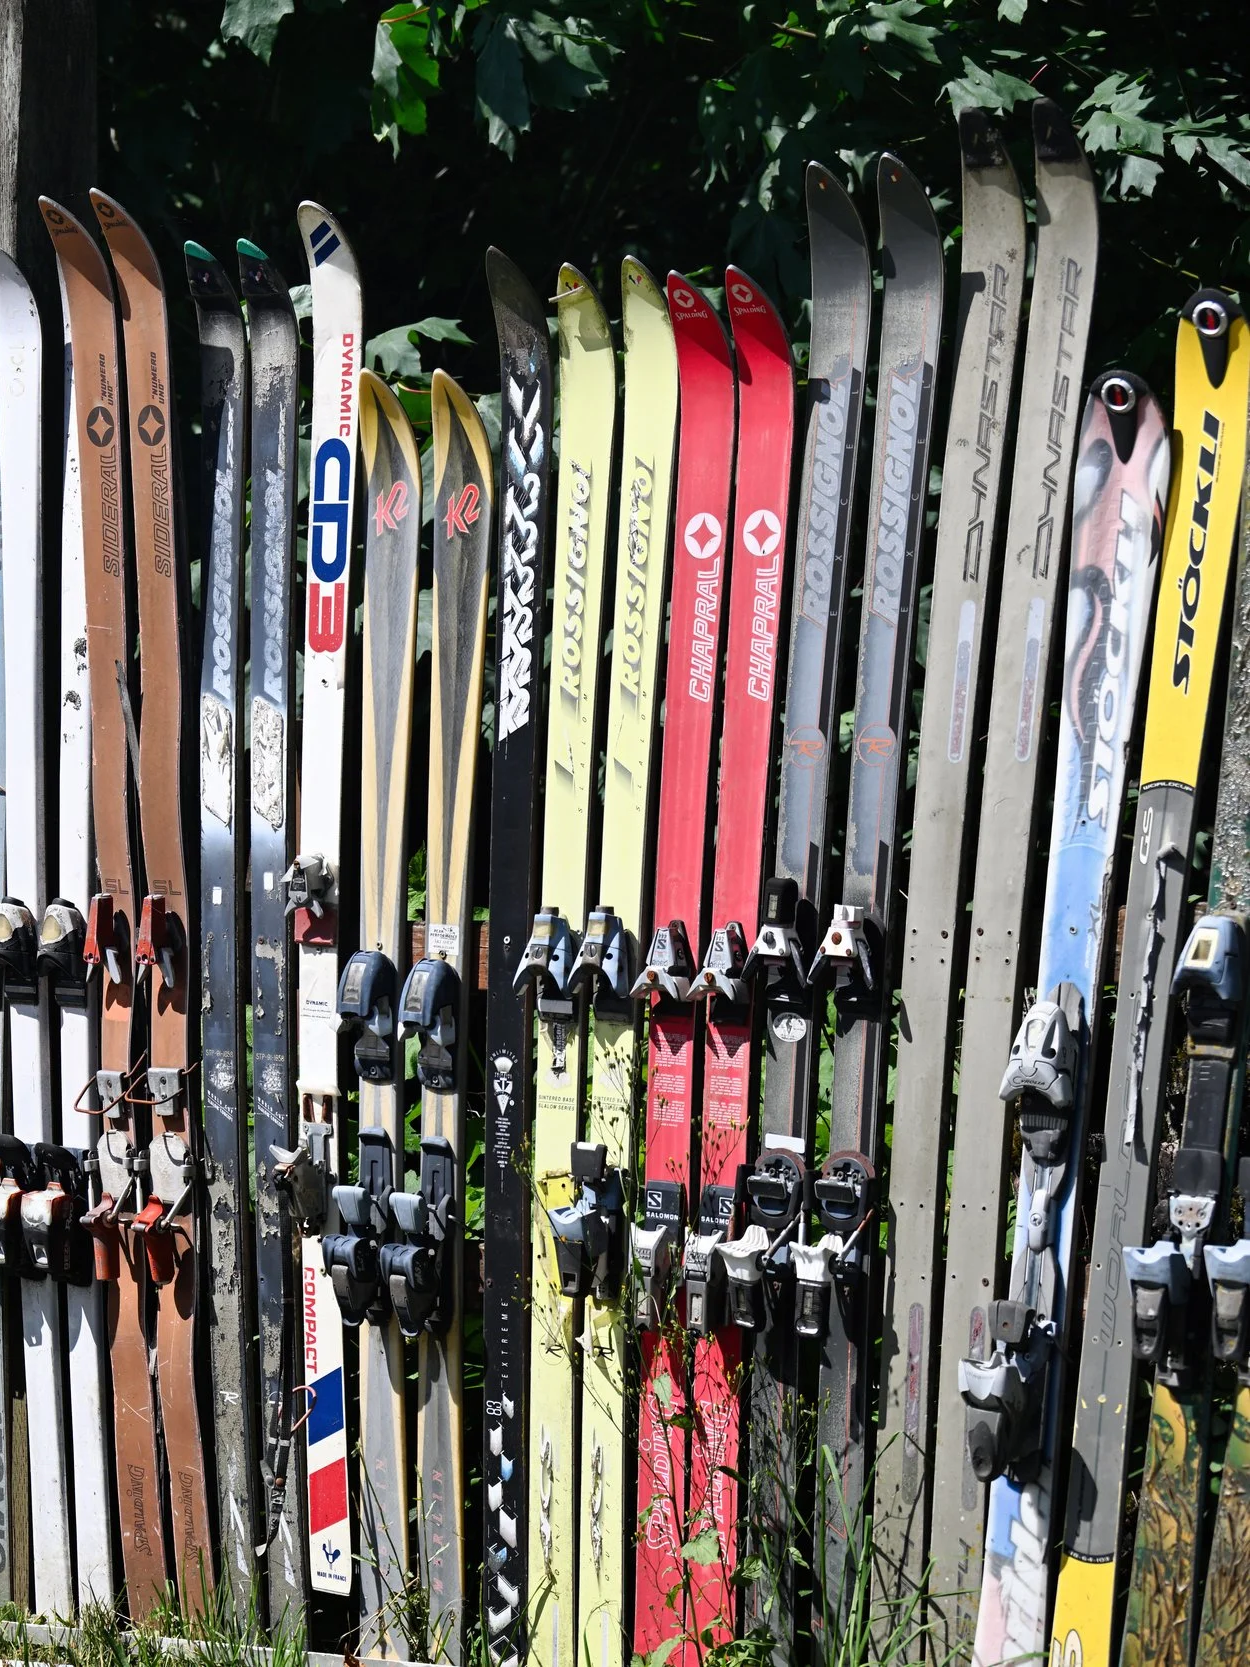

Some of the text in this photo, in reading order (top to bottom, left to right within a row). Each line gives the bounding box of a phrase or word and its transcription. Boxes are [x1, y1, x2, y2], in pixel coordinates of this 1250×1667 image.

[339, 333, 354, 437] DYNAMIC
[962, 264, 1009, 583] DYNASTAR
[1032, 258, 1083, 580] DYNASTAR
[103, 446, 120, 578] SIDERAL
[154, 444, 171, 578] SIDERAL
[308, 438, 351, 653] CD3
[373, 481, 409, 537] K2
[443, 483, 481, 539] K2
[801, 384, 846, 626] ROSSIGNOL
[873, 375, 917, 625] ROSSIGNOL
[1172, 409, 1220, 695] STÖCKLI
[689, 557, 721, 703] CHAPRAL
[748, 553, 780, 702] CHAPRAL
[1143, 781, 1193, 792] WORLDCUP
[306, 999, 328, 1007] DYNAMIC
[490, 1049, 518, 1064] UNLIMITED
[646, 1211, 678, 1220] SALOMON
[701, 1216, 729, 1225] SALOMO
[304, 1267, 317, 1374] COMPACT
[501, 1301, 509, 1378] EXTREME
[486, 1400, 502, 1416] 83
[693, 1400, 733, 1564] PALDING
[333, 1574, 347, 1582] FRANCE
